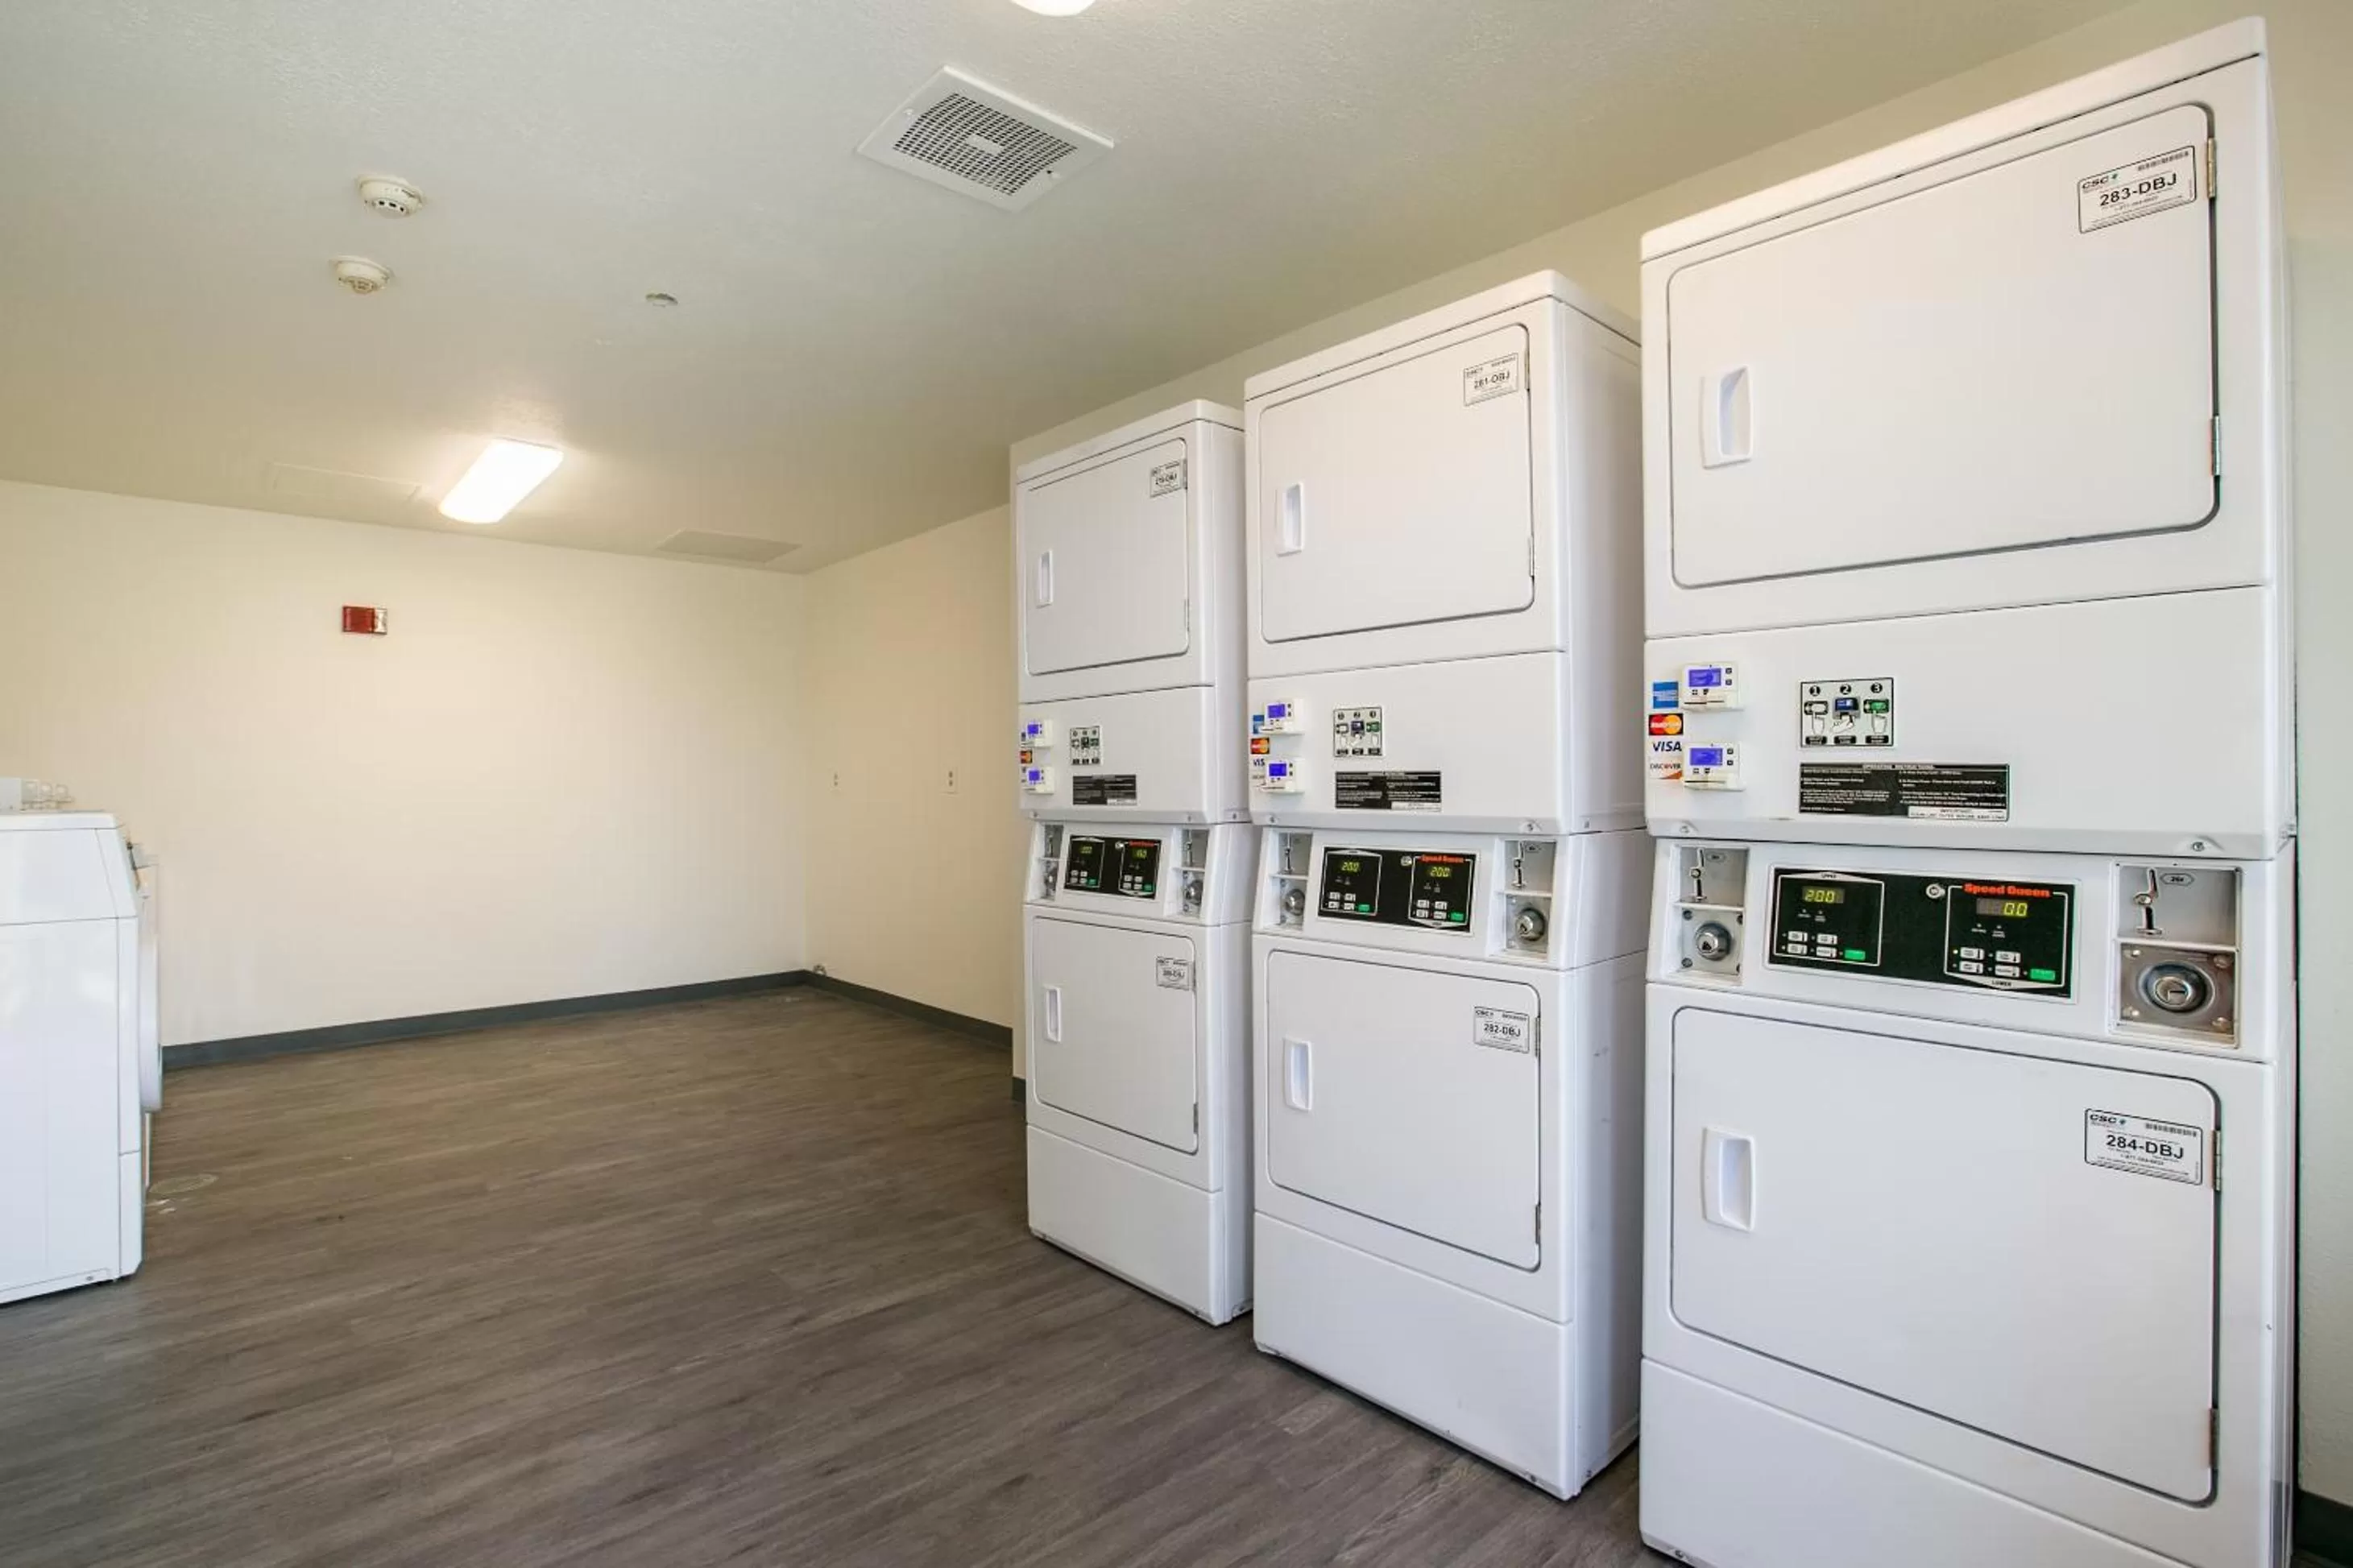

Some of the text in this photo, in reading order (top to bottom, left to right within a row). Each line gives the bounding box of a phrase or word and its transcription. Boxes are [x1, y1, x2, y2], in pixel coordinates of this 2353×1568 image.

[2082, 175, 2109, 190] CSC
[2099, 172, 2177, 207] 283-DBJ
[1652, 741, 1682, 752] VISA
[1804, 889, 1836, 904] 200
[1963, 883, 2051, 898] Speed Queen
[2090, 1114, 2117, 1125] CSC
[2105, 1134, 2185, 1160] 284-DBJ
